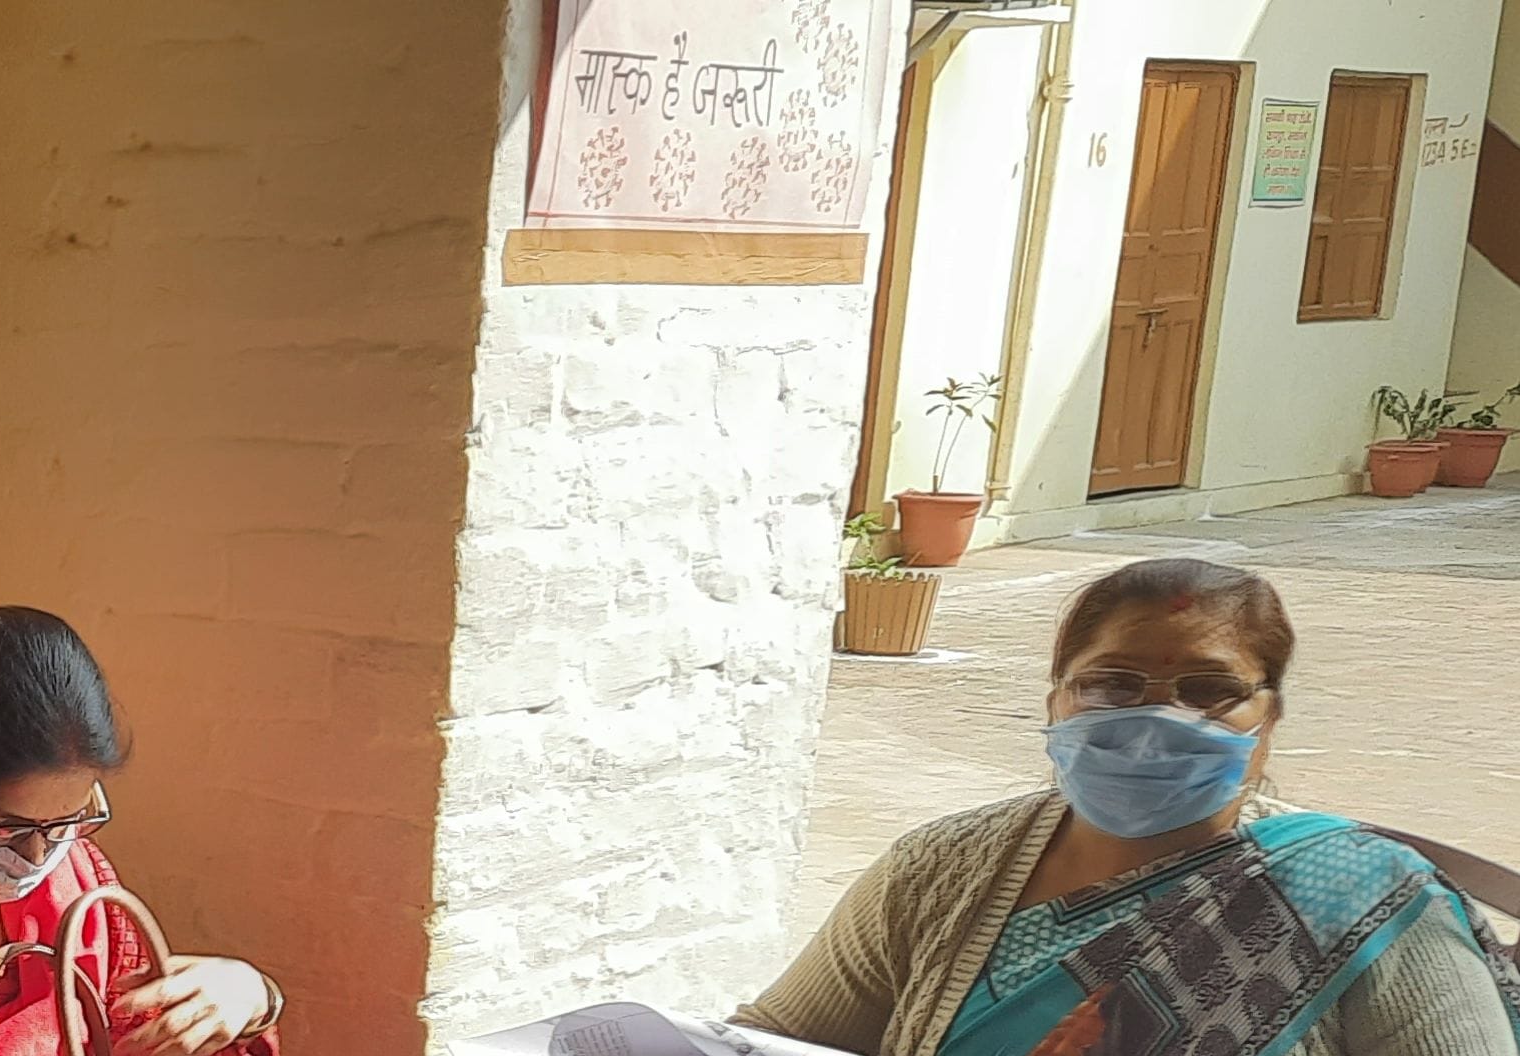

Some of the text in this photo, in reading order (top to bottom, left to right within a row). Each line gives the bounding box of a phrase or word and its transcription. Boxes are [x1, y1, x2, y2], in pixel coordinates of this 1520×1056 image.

[575, 50, 658, 115] मास्क
[661, 31, 689, 120] है
[1088, 132, 1108, 168] 16
